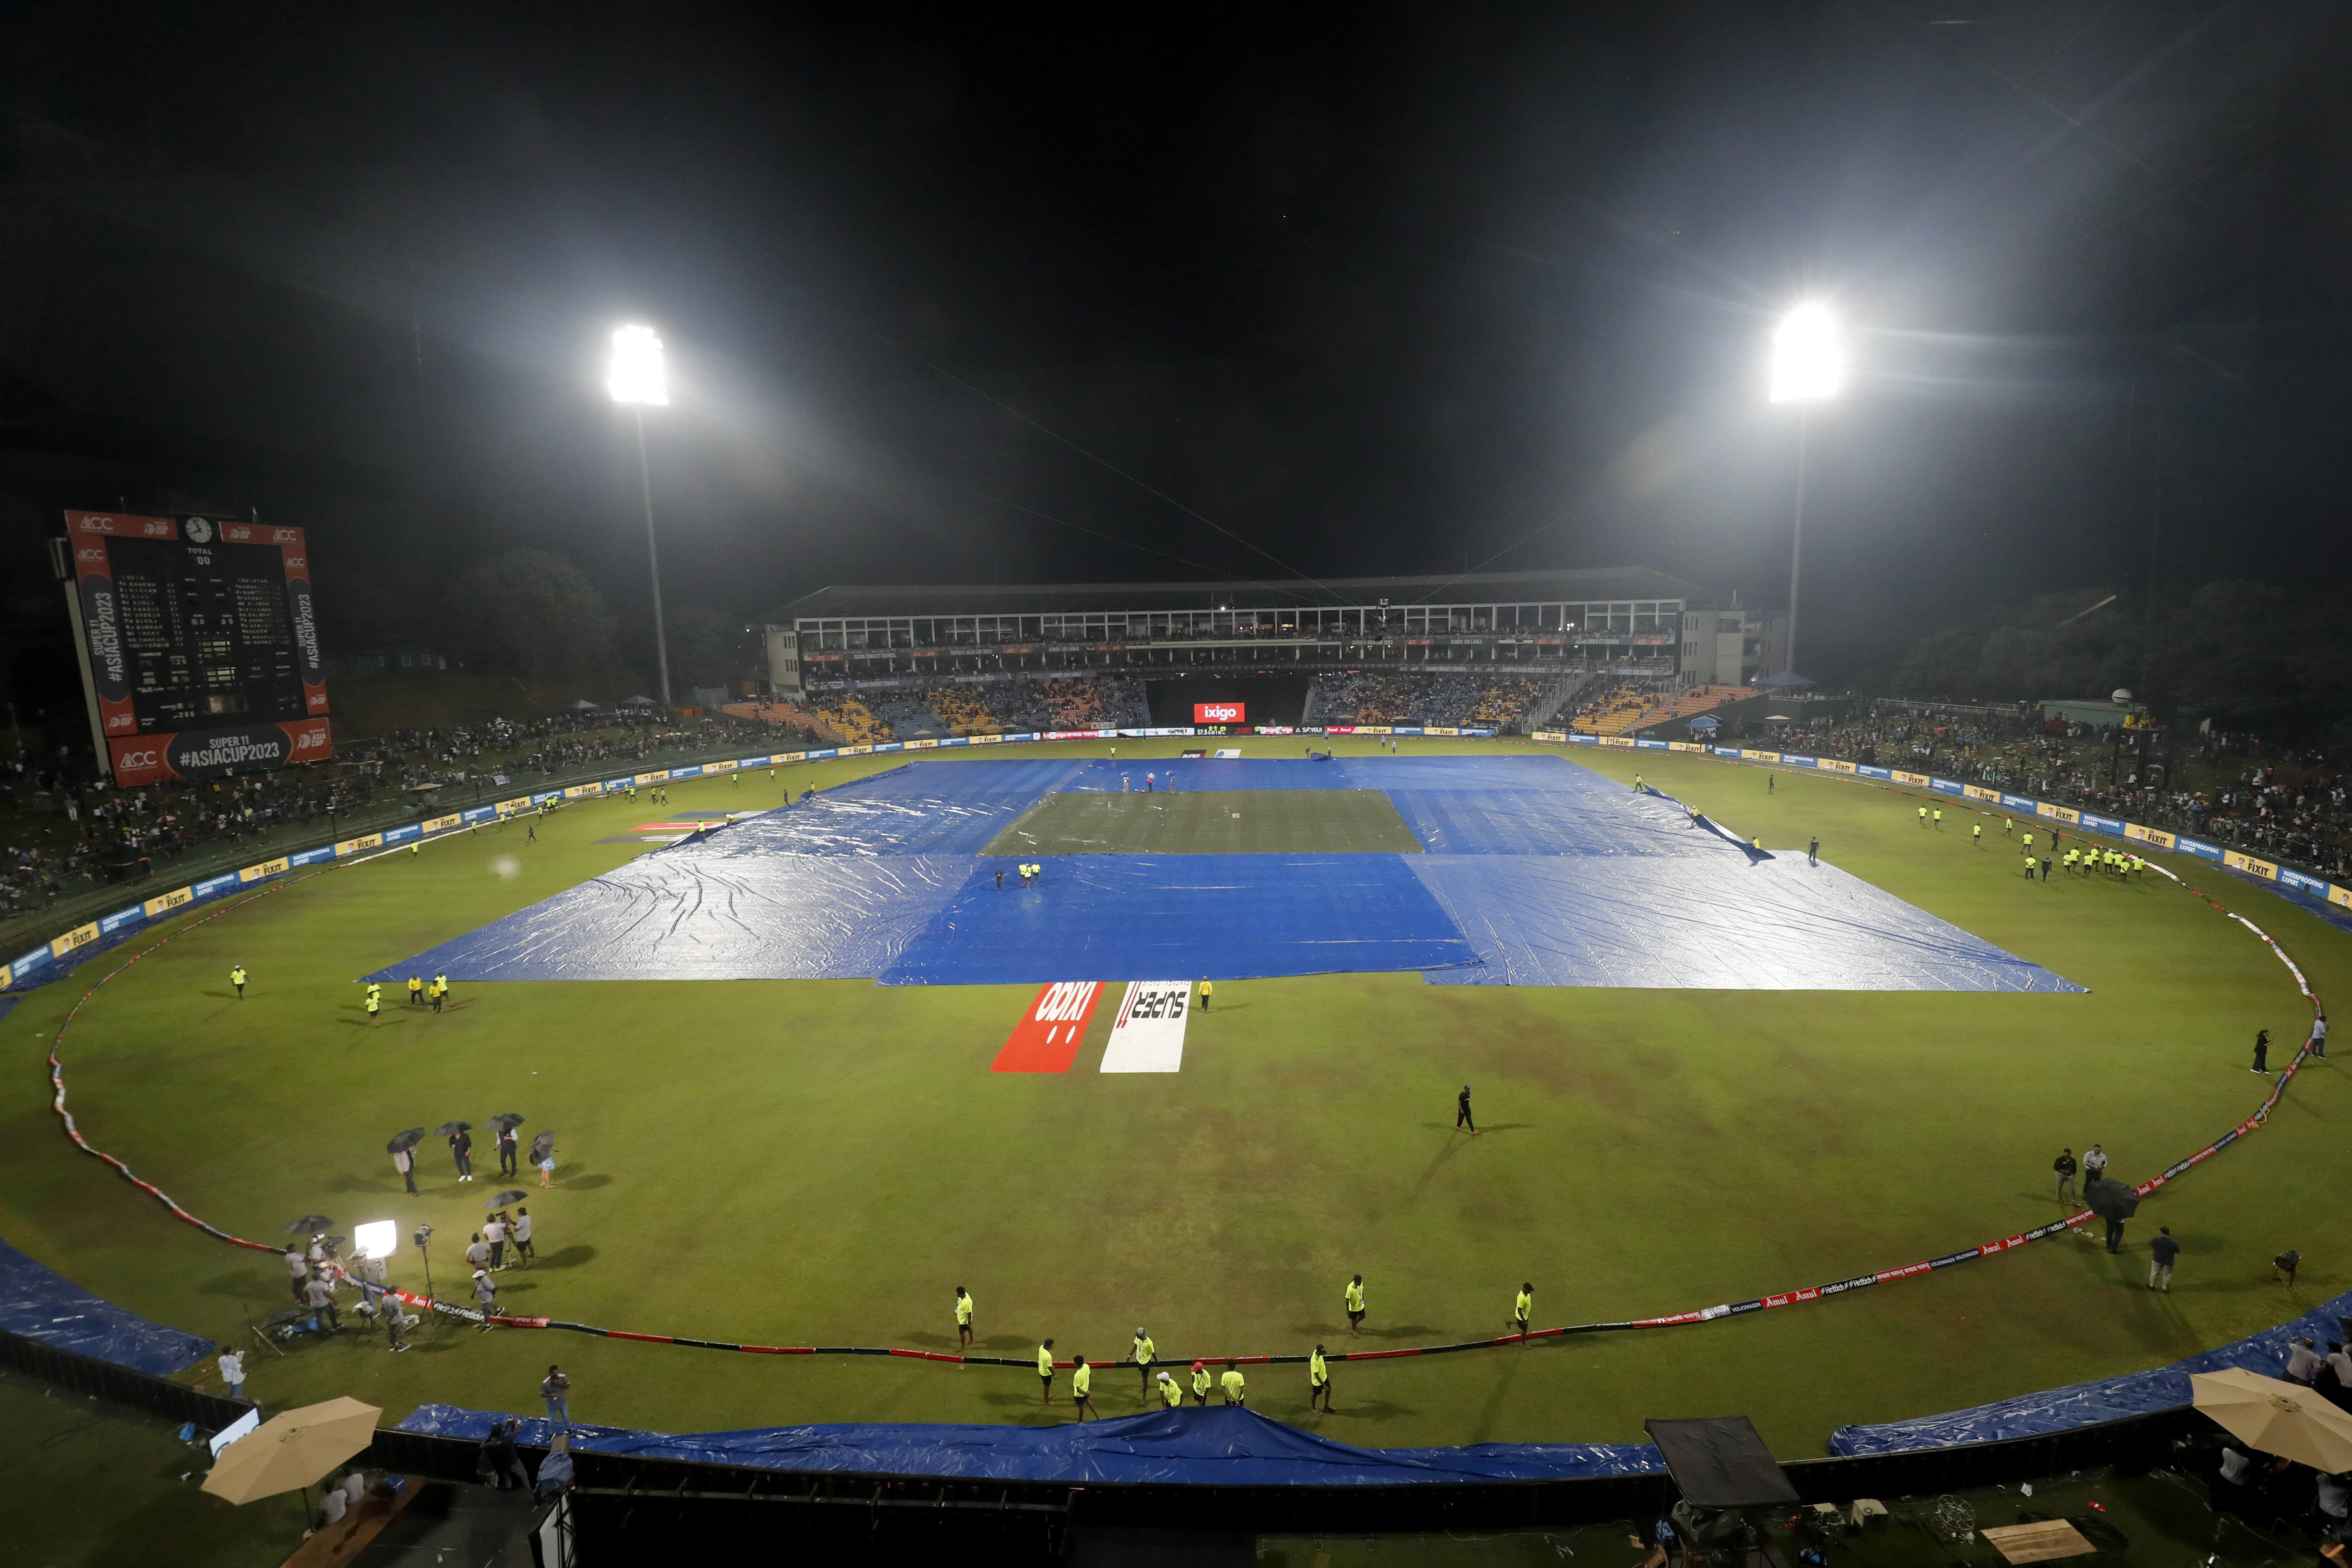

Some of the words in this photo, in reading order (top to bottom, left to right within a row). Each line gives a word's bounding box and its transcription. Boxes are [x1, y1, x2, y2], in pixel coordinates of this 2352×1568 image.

[80, 516, 113, 530] ACC
[273, 529, 296, 541] ACC
[95, 592, 124, 683] #ASIACUP2023
[297, 625, 306, 647] SUPER
[298, 594, 320, 669] #ASIACUP2023
[91, 629, 104, 656] SUPER
[1204, 705, 1237, 721] ixigo
[209, 737, 239, 749] SUPER
[240, 735, 249, 746] 11
[311, 739, 323, 747] CUP
[120, 751, 157, 769] ACC
[180, 742, 280, 768] #ASIACUP2023
[1859, 765, 1888, 774] WATERPROOFING
[1933, 779, 1960, 788] WATERPROOFING
[1979, 792, 1994, 802] FIXIT
[2004, 795, 2033, 806] WATERPROOFING
[464, 806, 492, 816] WATERPROOFING
[2055, 811, 2073, 821] FIXIT
[441, 818, 456, 827] FIXIT
[2084, 815, 2120, 828] WATERPROOFING
[386, 825, 419, 837] WATERPROOFING
[358, 839, 376, 850] FIXIT
[2147, 833, 2167, 845] FIXIT
[2179, 844, 2196, 853] EXPERT
[2180, 839, 2219, 854] WATERPROOFING
[292, 847, 331, 861] WATERPROOFING
[293, 858, 309, 866] EXPERT
[263, 863, 282, 876] FIXIT
[2248, 863, 2269, 876] FIXIT
[196, 874, 235, 890] WATERPROOFING
[2282, 876, 2299, 887] EXPERT
[2283, 870, 2324, 889] WATERPROOFING
[197, 886, 214, 896] EXPERT
[167, 894, 186, 908] FIXIT
[102, 907, 141, 926] WATERPROOFING
[103, 921, 120, 932] EXPERT
[73, 930, 93, 946] FIXIT
[1132, 991, 1187, 1019] SUPER
[2137, 1183, 2151, 1195] Amul
[2151, 1176, 2165, 1187] Amul
[2028, 1228, 2044, 1240] Hettich
[1982, 1242, 2001, 1255] Amul
[2006, 1235, 2024, 1248] Amul
[1930, 1258, 1956, 1268] VOLKSWAGEN
[1955, 1250, 1979, 1261] VOLKSWAGEN
[1825, 1284, 1845, 1294] Hettich
[1853, 1277, 1873, 1287] Hettich
[1766, 1295, 1788, 1308] Amul
[1796, 1289, 1817, 1302] Amul
[1732, 1302, 1761, 1312] VOLKSWAGEN
